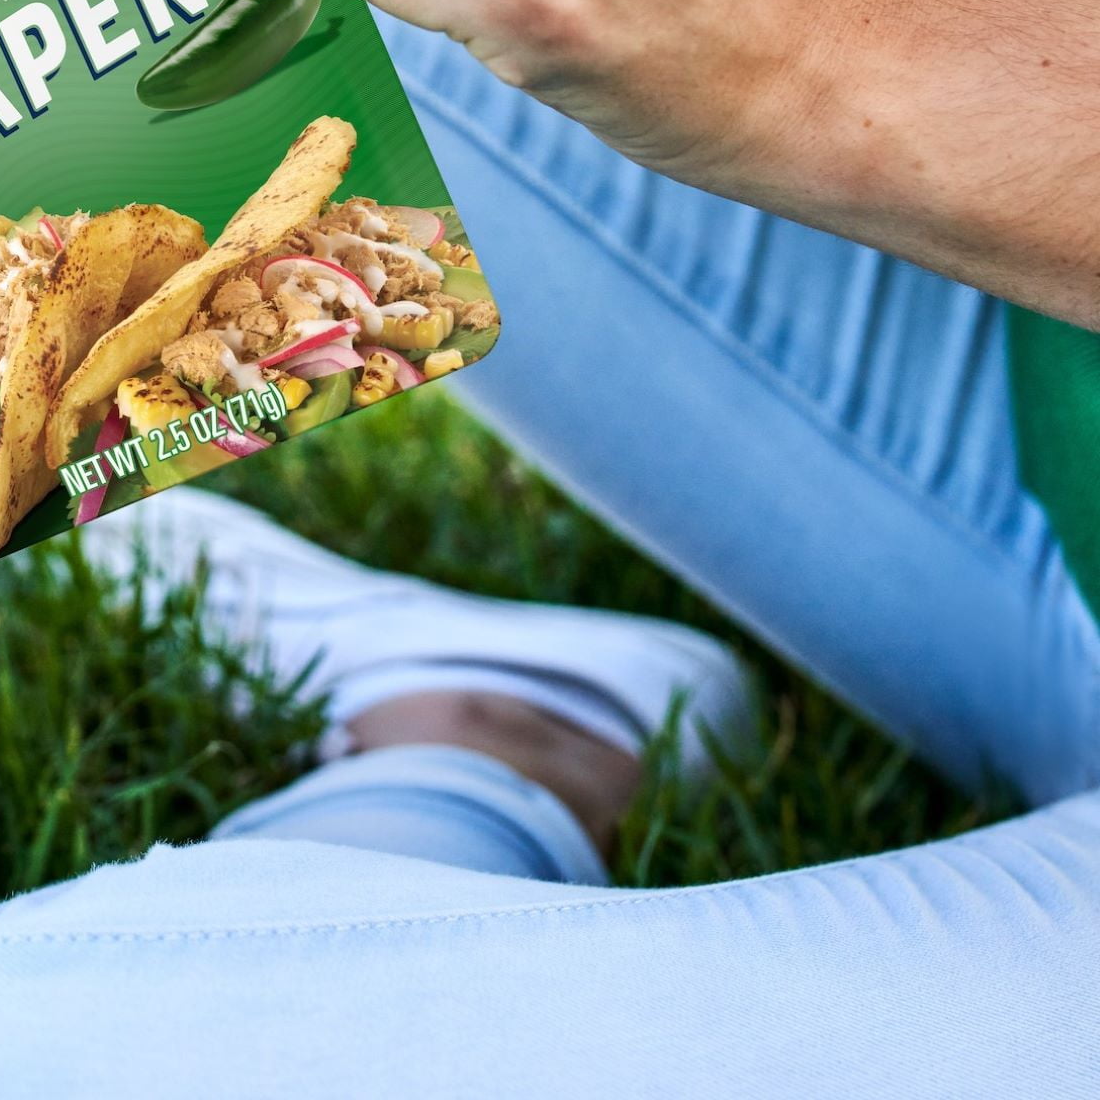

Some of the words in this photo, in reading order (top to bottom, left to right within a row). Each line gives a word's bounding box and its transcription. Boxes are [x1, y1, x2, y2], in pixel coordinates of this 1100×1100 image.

[60, 454, 108, 497] NET
[106, 436, 149, 478] WT
[149, 419, 191, 461] 2.5
[190, 405, 228, 444] OZ
[226, 382, 288, 433] (71g)
